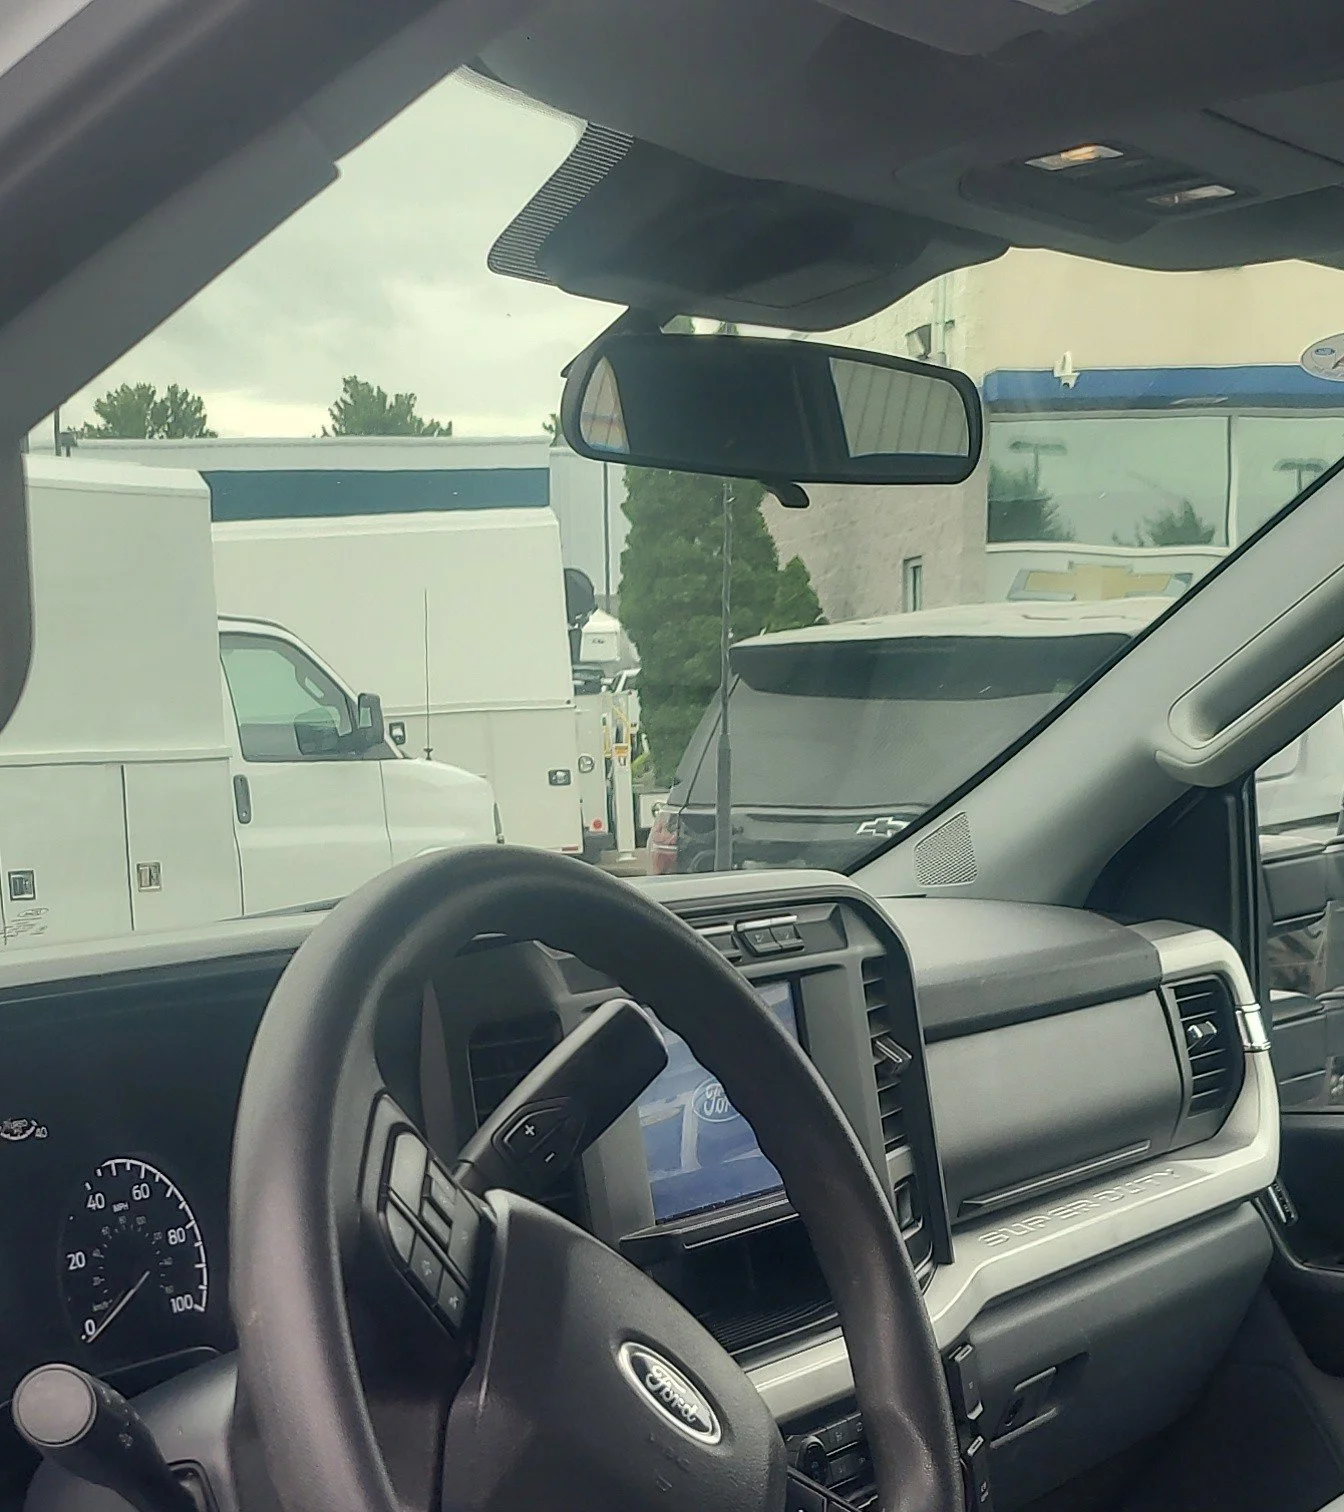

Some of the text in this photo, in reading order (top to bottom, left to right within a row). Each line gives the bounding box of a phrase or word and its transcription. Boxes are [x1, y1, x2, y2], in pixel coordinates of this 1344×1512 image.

[131, 1183, 151, 1201] 60
[86, 1193, 106, 1210] 40
[112, 1202, 130, 1213] MPH
[978, 1167, 1180, 1247] SUPER DUTY
[167, 1227, 187, 1245] 80
[66, 1251, 86, 1270] 20
[170, 1294, 194, 1313] 100
[84, 1319, 96, 1336] 0
